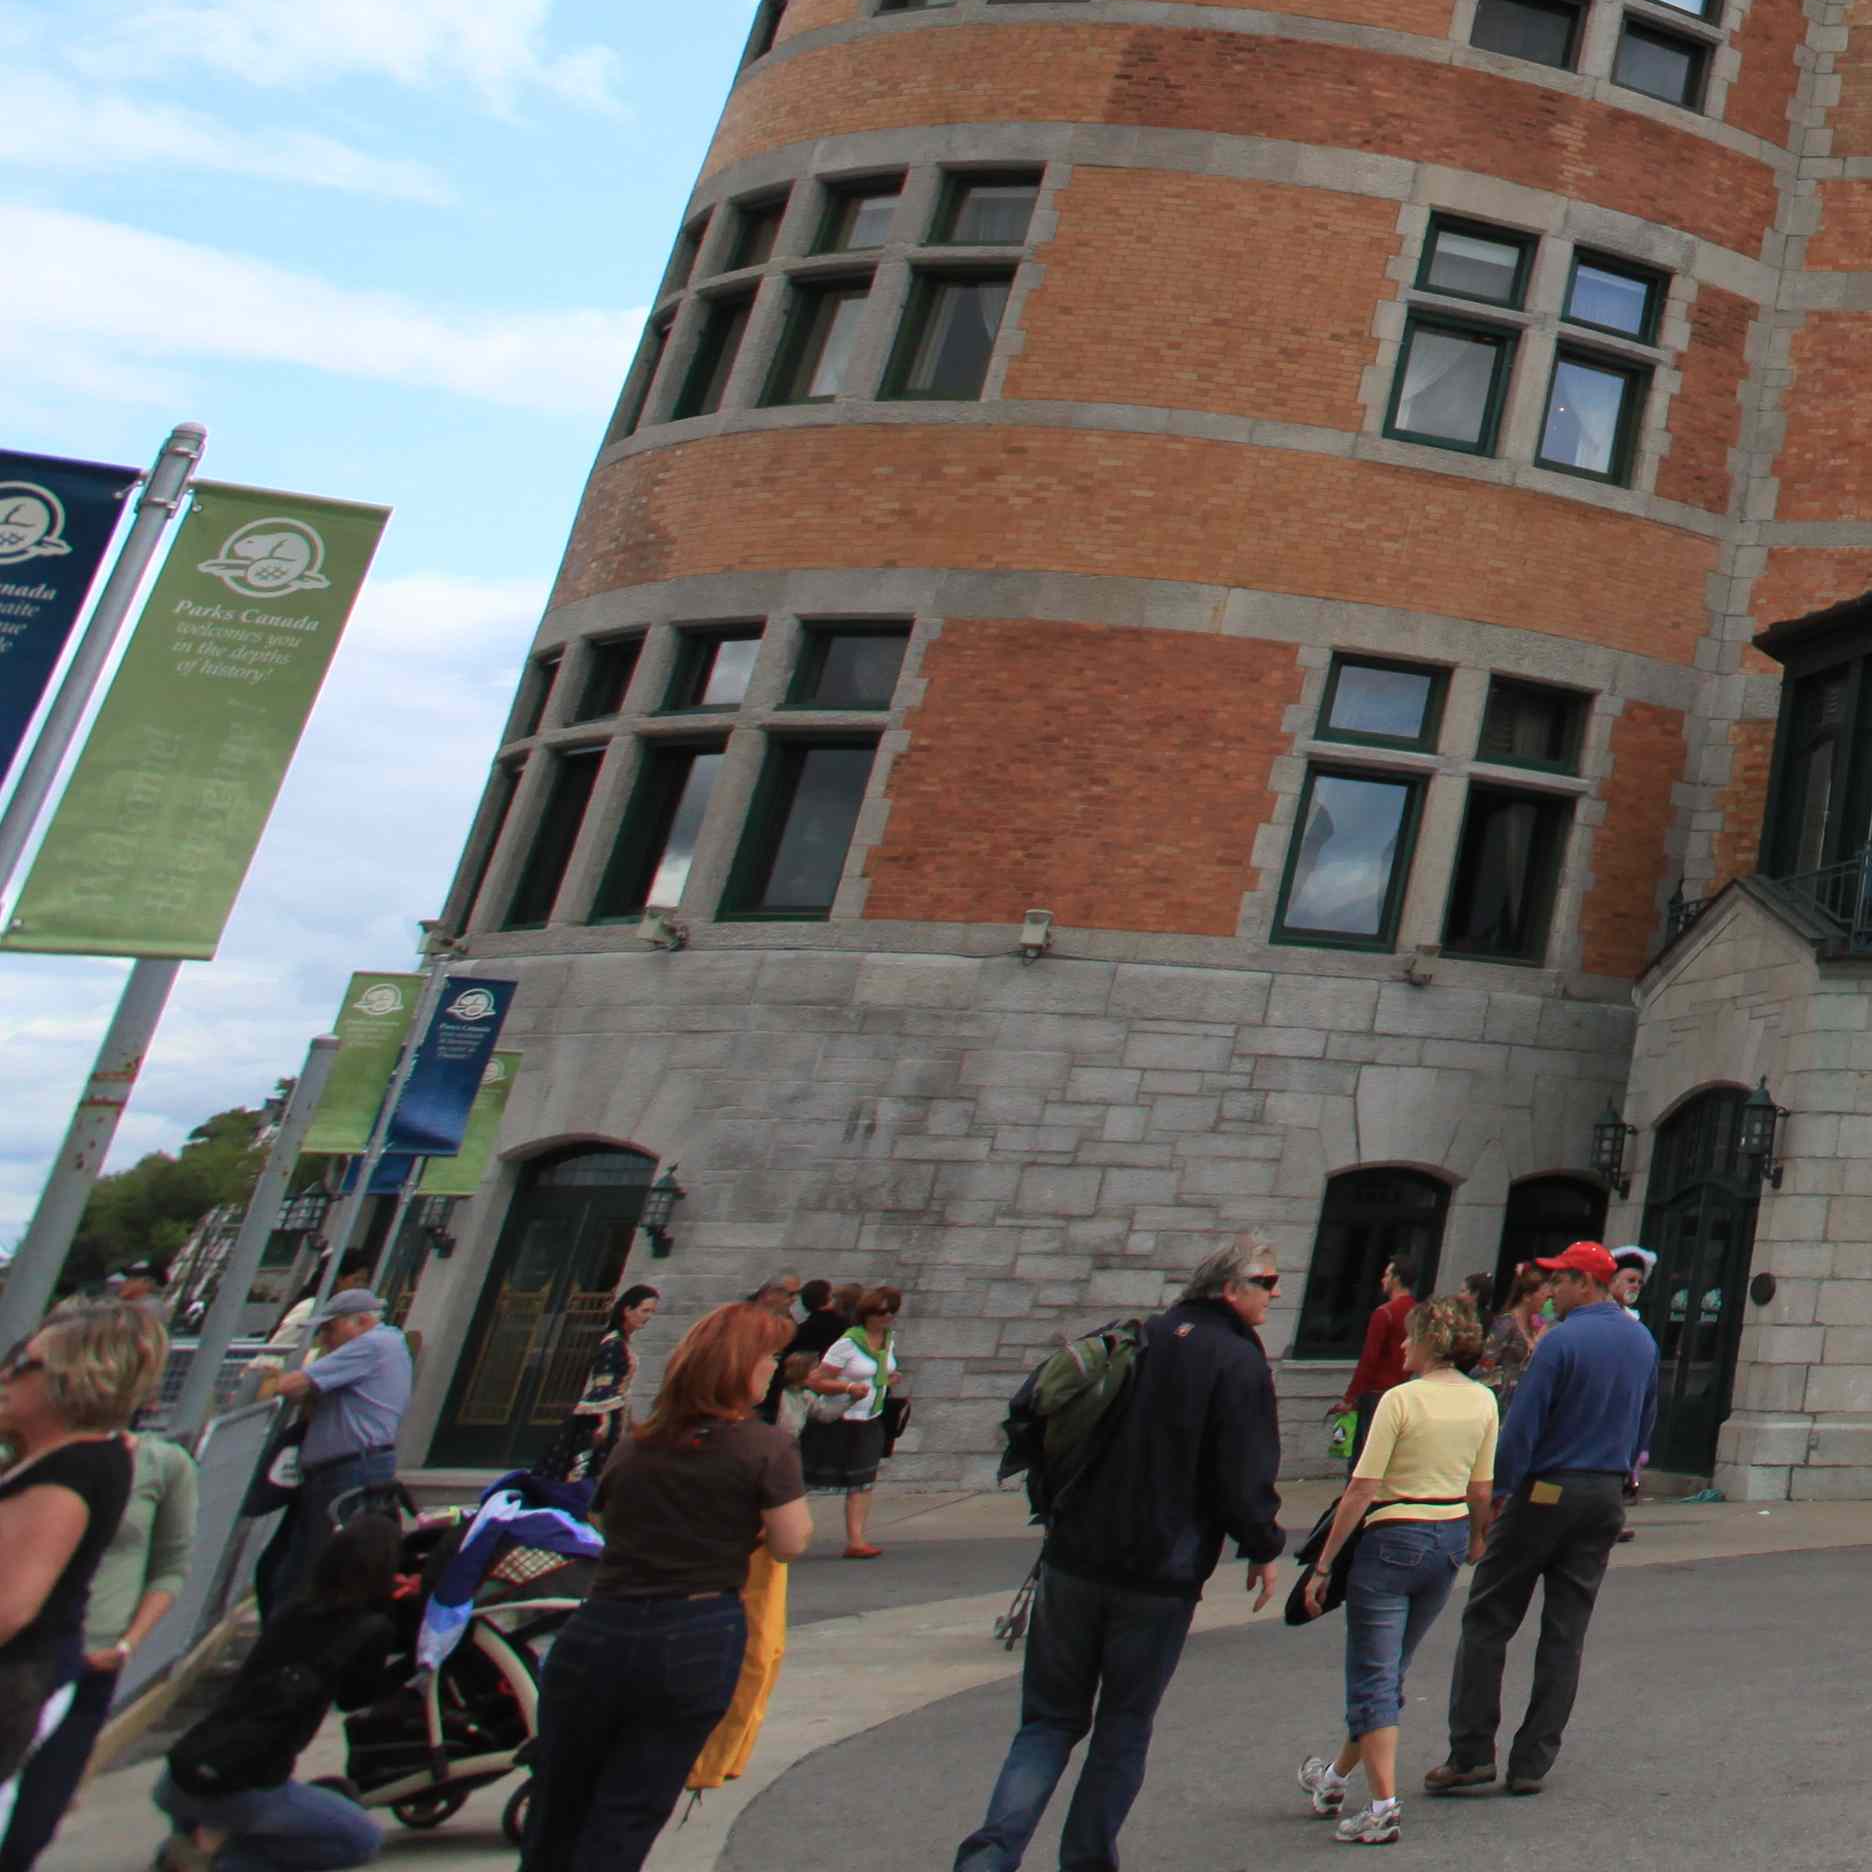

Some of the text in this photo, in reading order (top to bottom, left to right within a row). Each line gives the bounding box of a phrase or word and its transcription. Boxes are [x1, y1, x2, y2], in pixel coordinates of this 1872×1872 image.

[0, 583, 56, 600] nada
[172, 599, 320, 631] Parks Canada
[176, 621, 301, 650] welcomes you
[171, 639, 292, 665] in the depths
[175, 658, 199, 677] of
